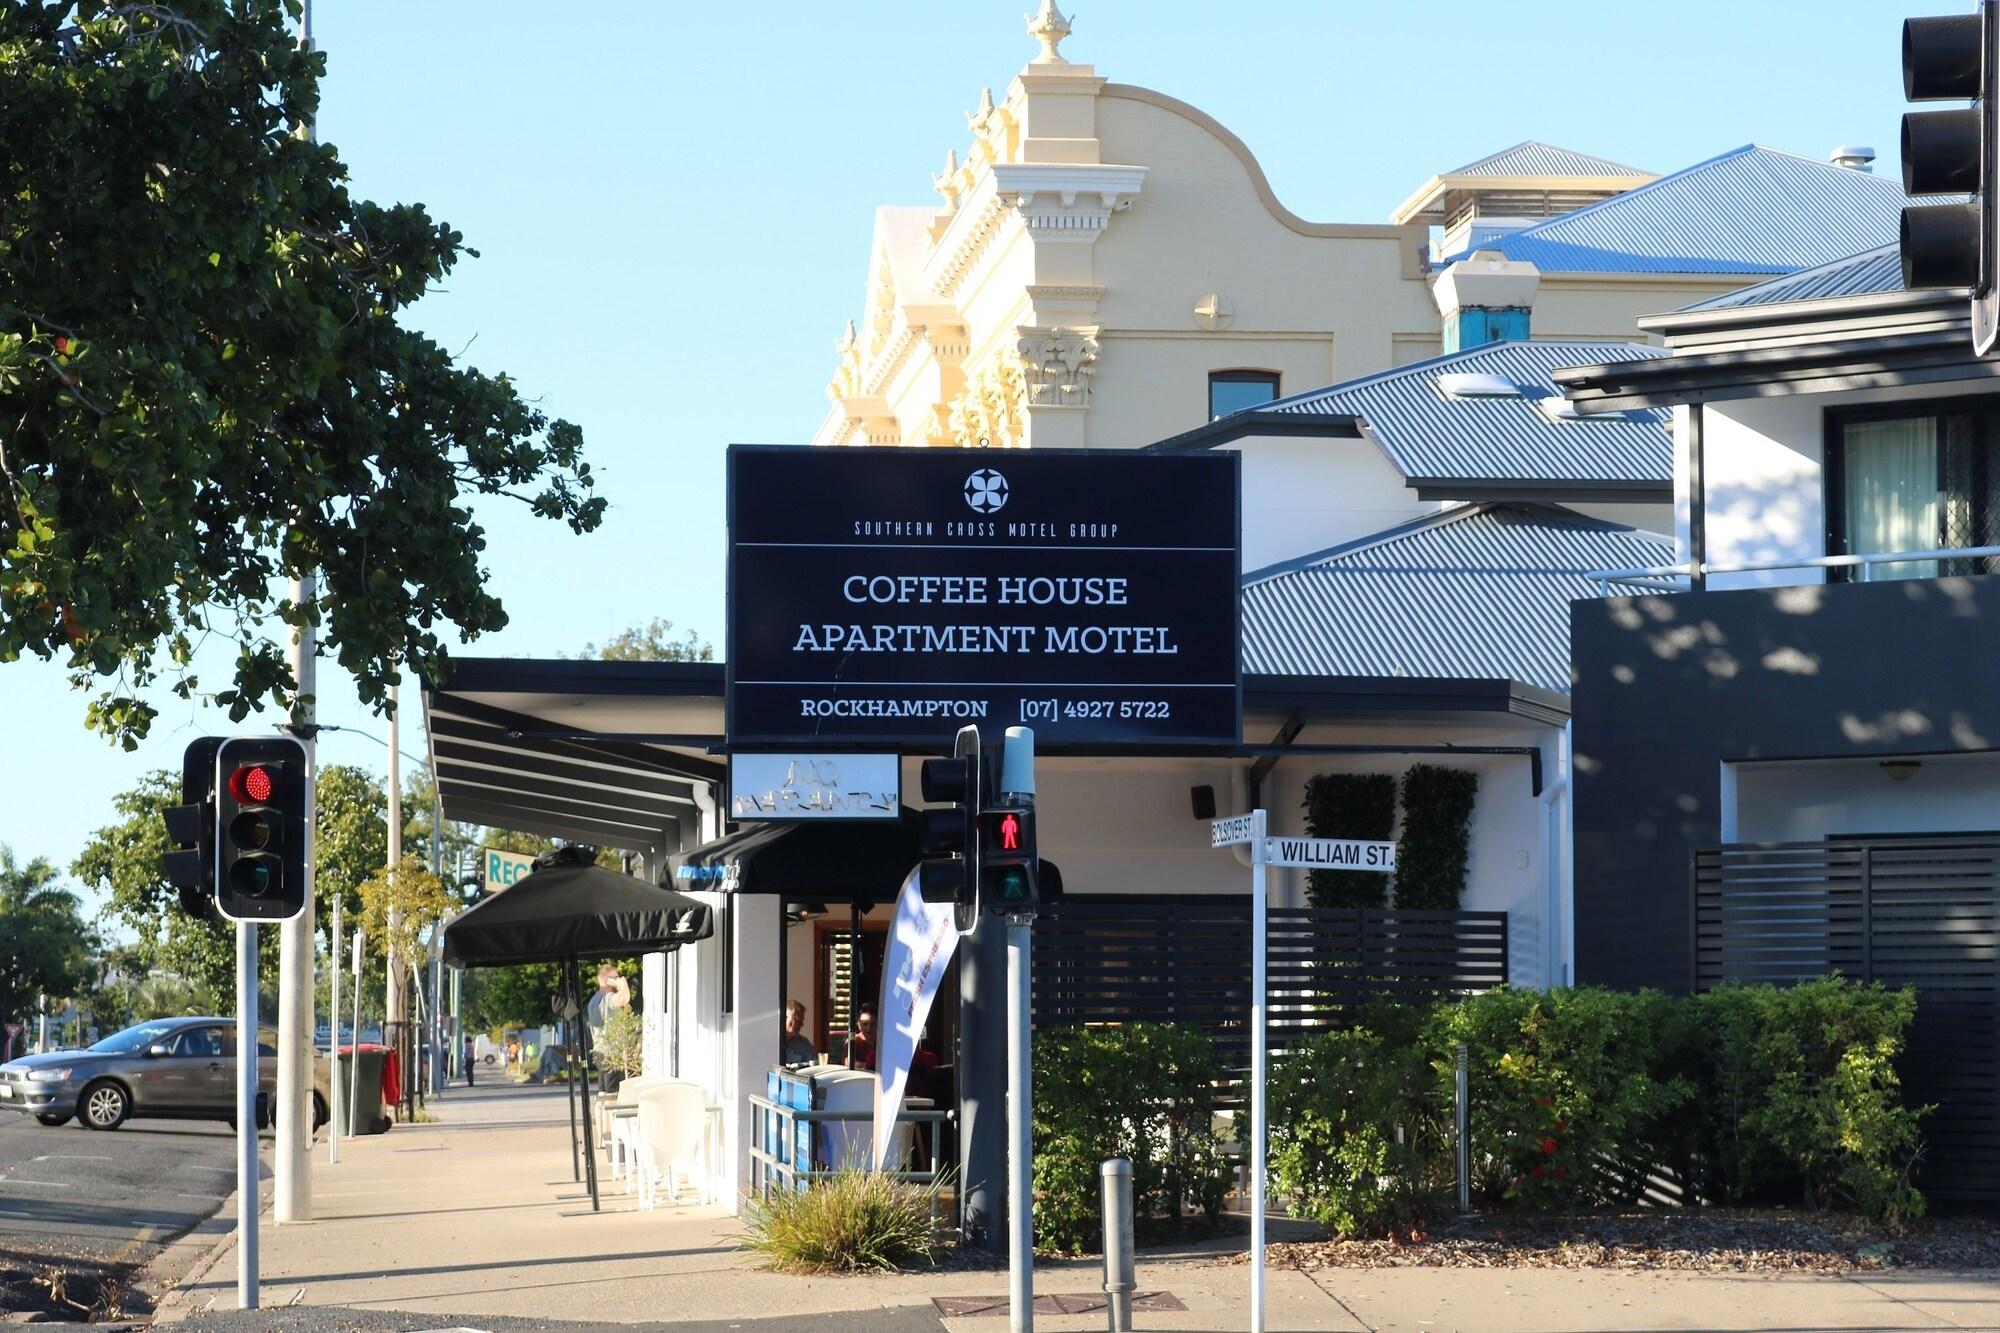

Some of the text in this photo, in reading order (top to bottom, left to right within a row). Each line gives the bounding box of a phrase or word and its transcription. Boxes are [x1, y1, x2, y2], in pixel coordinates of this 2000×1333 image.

[854, 520, 1118, 538] SOUTHERN CROSS MOTEL GROUP
[843, 575, 1128, 605] COFFEE HOUSE
[792, 624, 1178, 654] APARTMENT MOTEL
[800, 698, 1170, 723] ROCKHAMPTON [07] 4927 5722
[1212, 819, 1242, 844] BOLSOVER
[1281, 841, 1394, 867] WILLIAM ST.
[488, 852, 532, 885] REC
